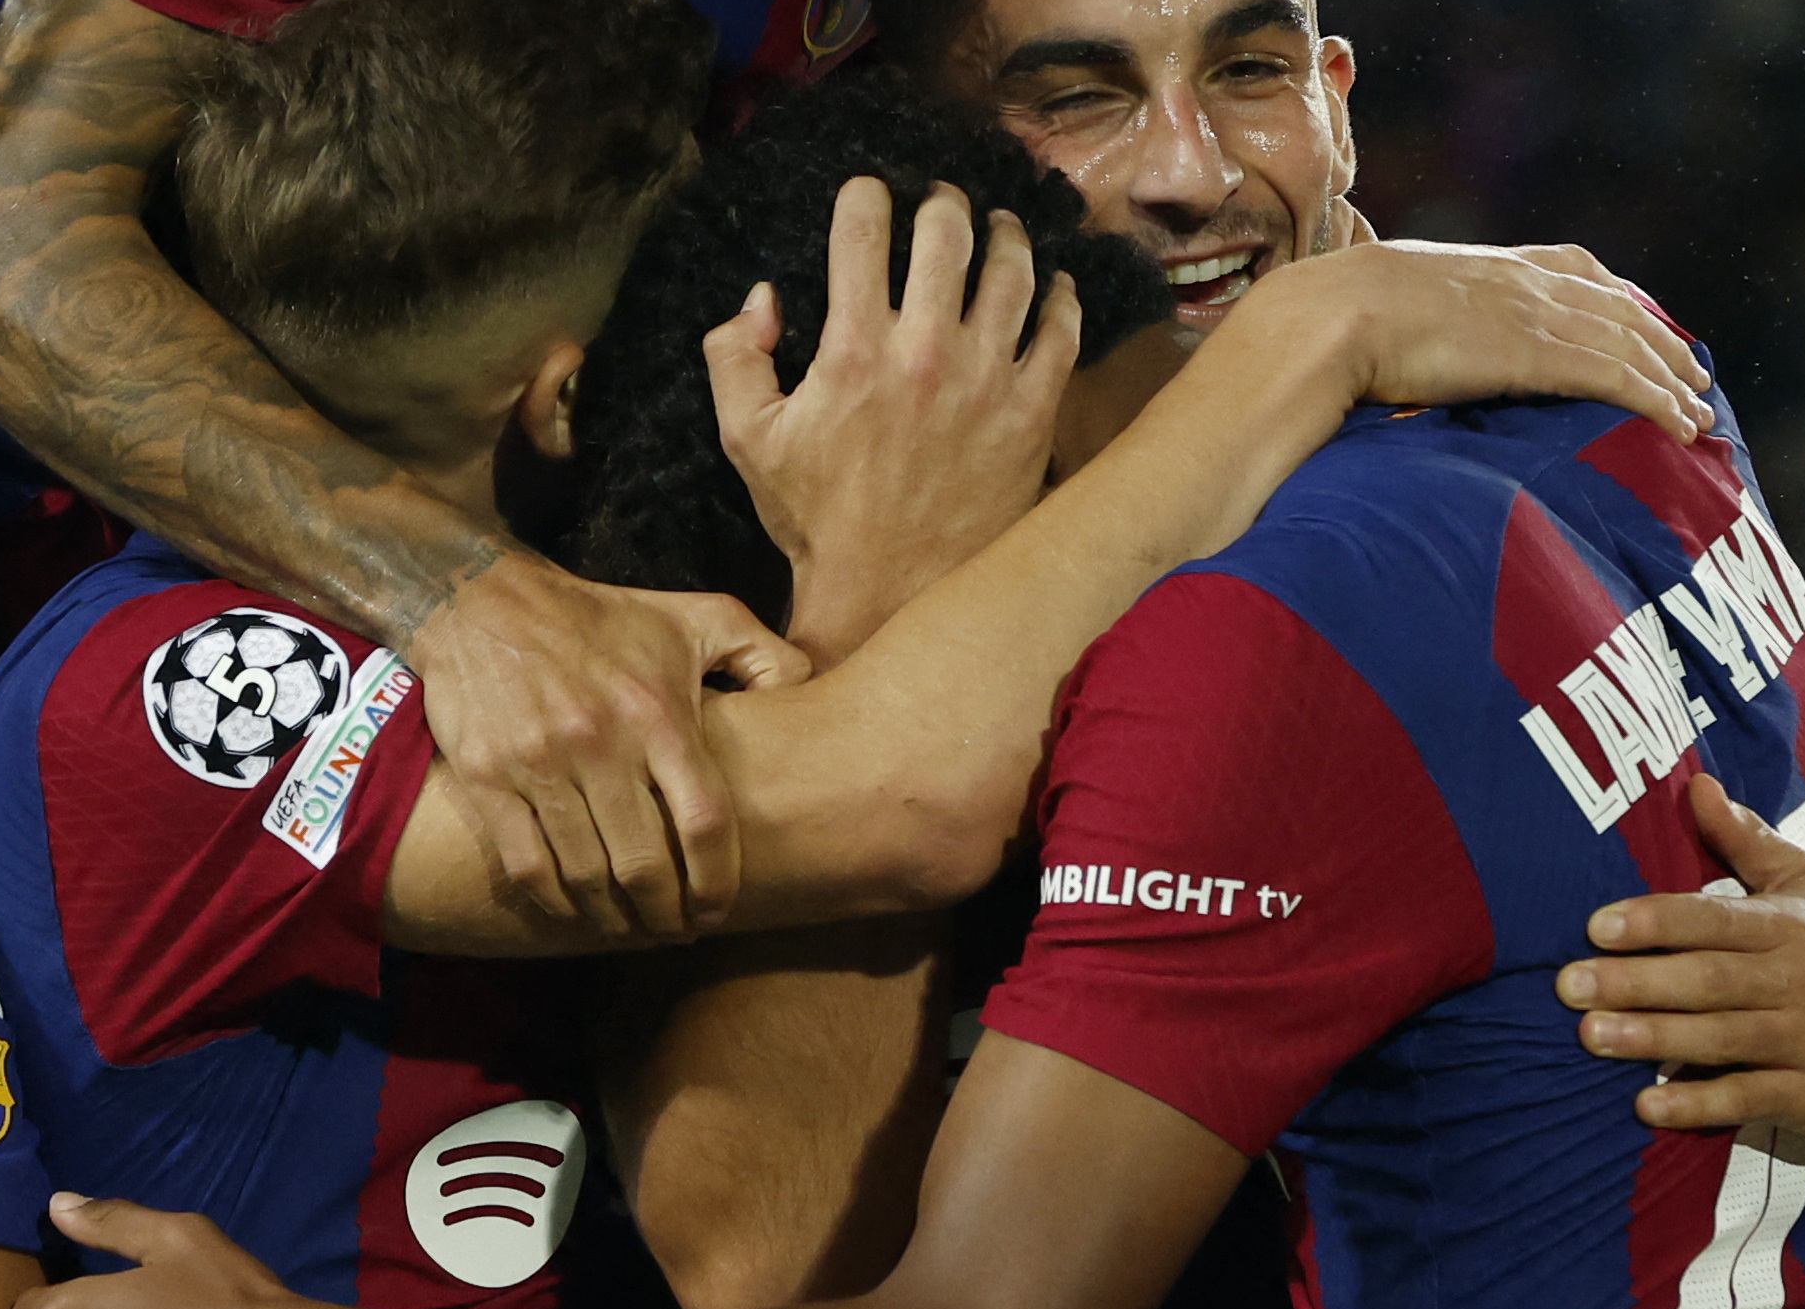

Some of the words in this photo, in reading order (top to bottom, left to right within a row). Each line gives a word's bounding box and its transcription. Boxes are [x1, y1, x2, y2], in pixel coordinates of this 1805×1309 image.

[204, 653, 278, 717] 5
[287, 669, 415, 849] FOUNDATIO
[271, 778, 306, 830] UEFA
[1040, 864, 1245, 916] MBILIGHT
[1256, 884, 1303, 919] tv
